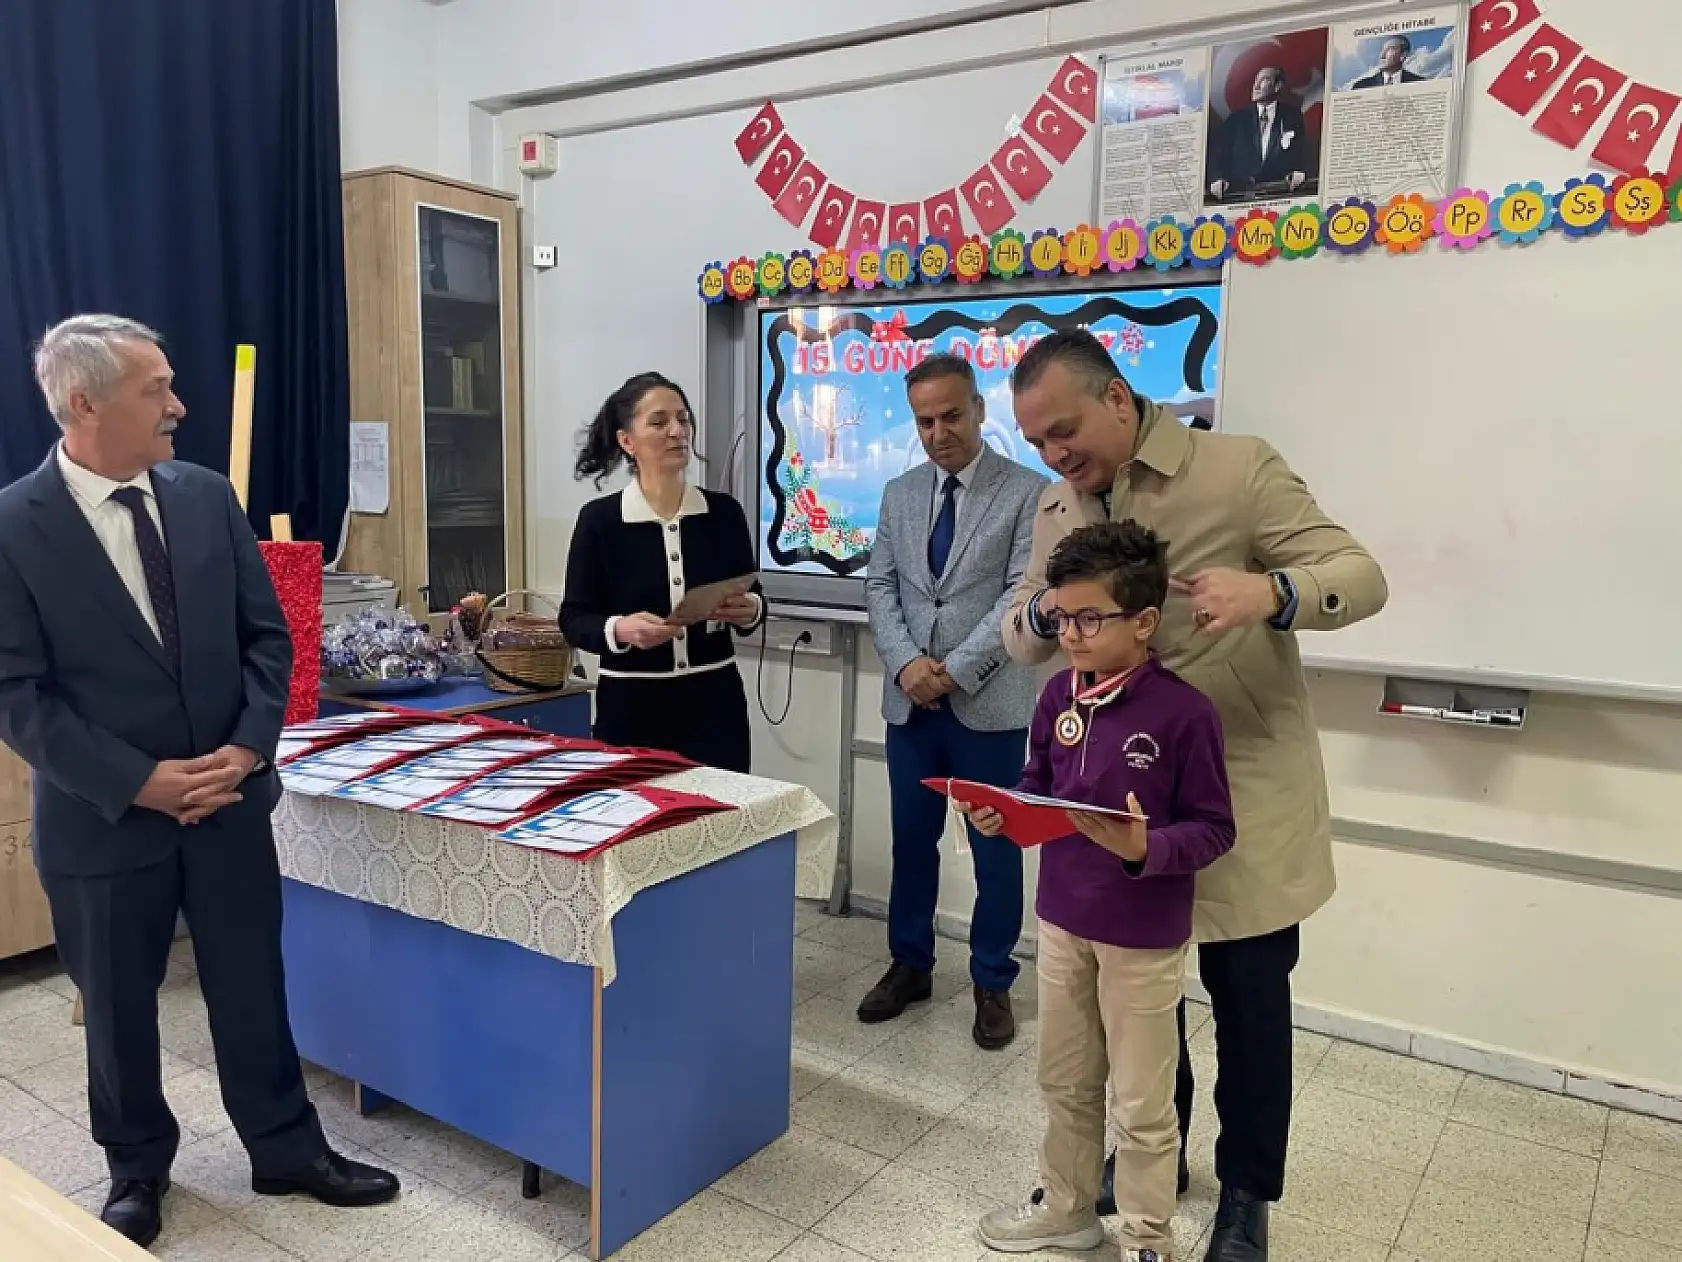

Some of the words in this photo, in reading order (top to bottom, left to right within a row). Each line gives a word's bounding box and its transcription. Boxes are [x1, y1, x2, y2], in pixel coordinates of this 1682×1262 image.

[735, 270, 751, 286] Bb
[764, 262, 781, 281] Cc
[823, 260, 843, 277] Dd
[861, 255, 878, 274] Ee
[890, 253, 904, 279] Ff
[921, 249, 942, 275] Gg
[996, 244, 1020, 263] Hh
[1115, 235, 1129, 259] Jj
[1155, 231, 1177, 252] Kk
[1199, 230, 1216, 249] Ll
[1241, 227, 1274, 246] Mm
[1285, 220, 1315, 240] Nn
[1331, 213, 1366, 234] Oo
[1387, 206, 1423, 233] Öö
[1451, 203, 1480, 234] Pp
[1511, 199, 1537, 222] Rr
[1570, 192, 1596, 216] Ss
[1624, 186, 1651, 216] Şş
